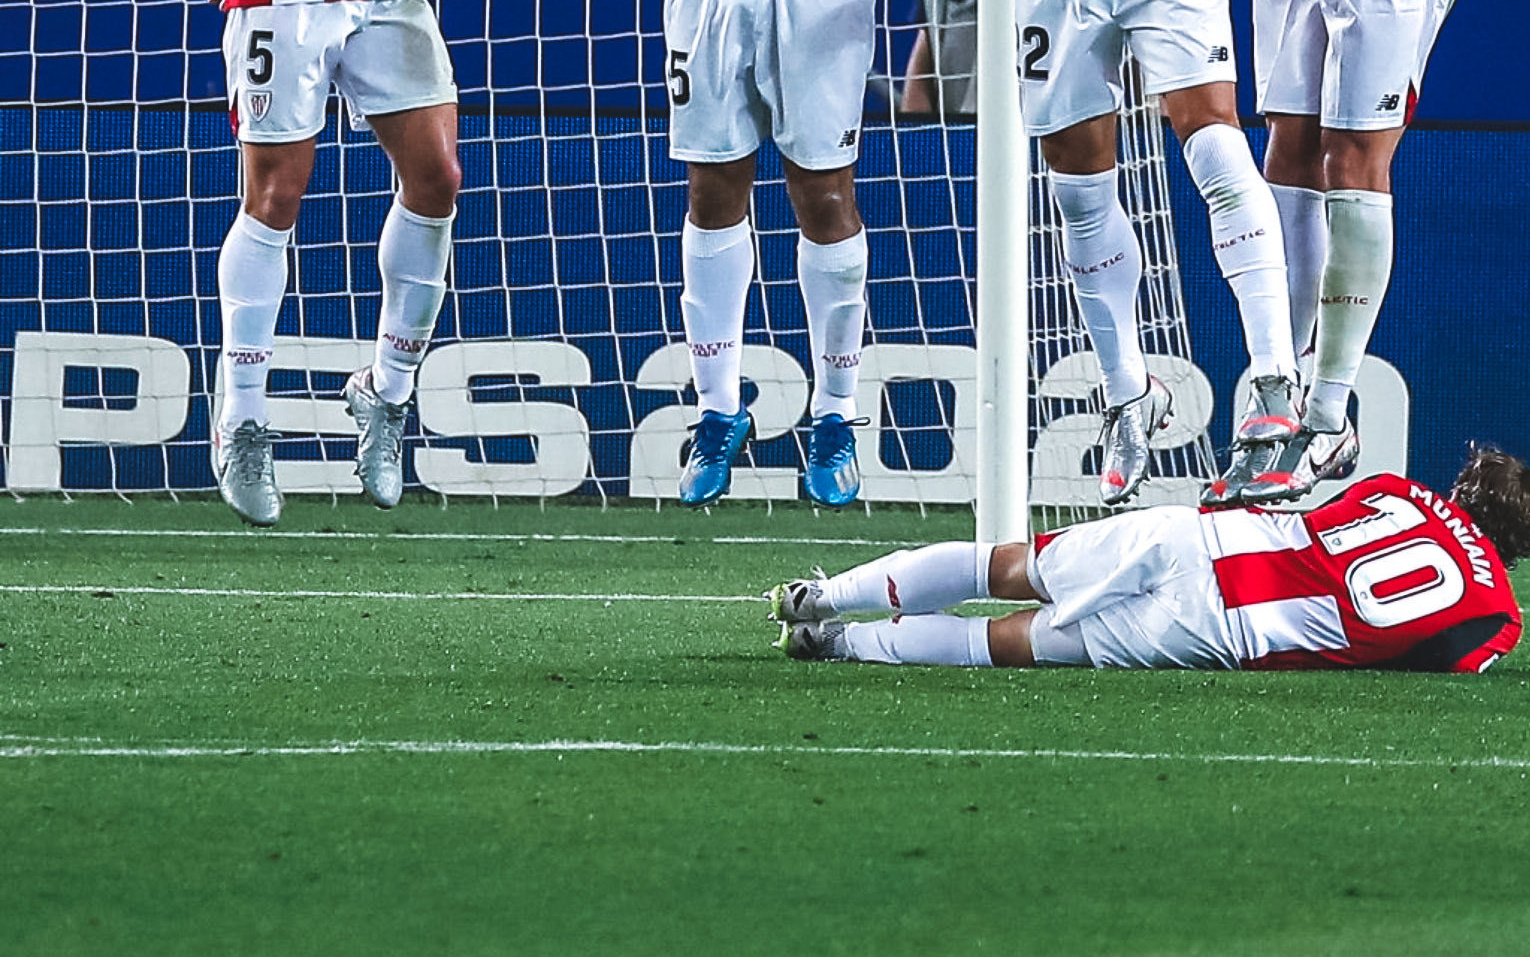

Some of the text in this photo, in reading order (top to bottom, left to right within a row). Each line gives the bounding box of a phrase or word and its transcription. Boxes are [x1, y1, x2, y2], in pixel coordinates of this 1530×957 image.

[246, 29, 275, 85] 5
[670, 49, 691, 107] 5
[1015, 23, 1050, 82] 2
[1316, 492, 1467, 628] 10
[1409, 484, 1495, 588] MUNIAIN
